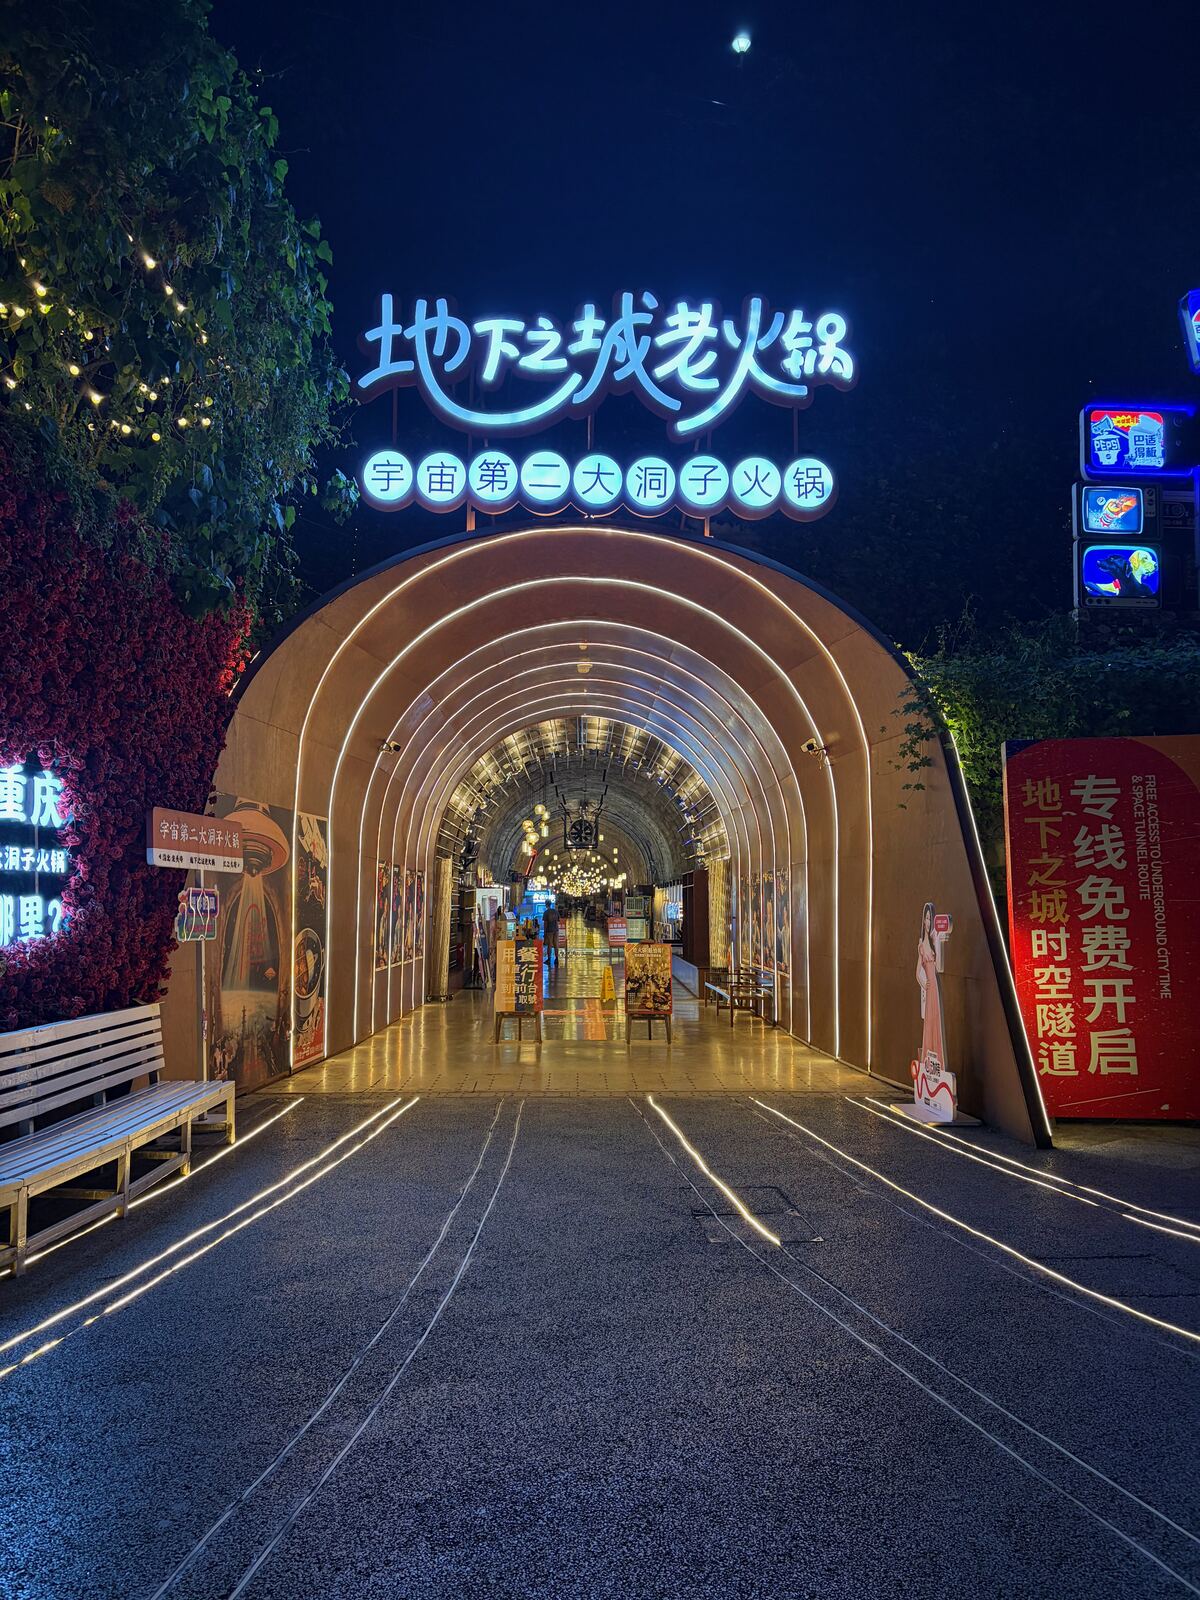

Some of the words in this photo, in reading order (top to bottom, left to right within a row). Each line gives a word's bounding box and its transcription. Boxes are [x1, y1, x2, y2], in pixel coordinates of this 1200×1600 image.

[358, 291, 853, 433] 地下之城老火锅
[370, 457, 828, 502] 宇宙第二大洞子火锅
[0, 764, 64, 828] 重庆
[1131, 775, 1143, 784] &
[1145, 775, 1157, 800] FREE
[1132, 785, 1145, 818] SPACE
[159, 819, 240, 849] 宇宙第二大洞子火锅
[1147, 802, 1160, 842] ACCESS
[1135, 820, 1148, 862] TUNNEL
[1150, 844, 1161, 859] TO
[0, 846, 66, 873] 洞子火锅
[1137, 864, 1151, 900] ROUTE
[1151, 861, 1168, 946] UNDERGROUND
[1021, 777, 1080, 1078] 地下之城时空隧道
[1070, 774, 1139, 1076] 专线免费开启
[1157, 948, 1170, 972] CITY
[1159, 973, 1172, 999] TIME
